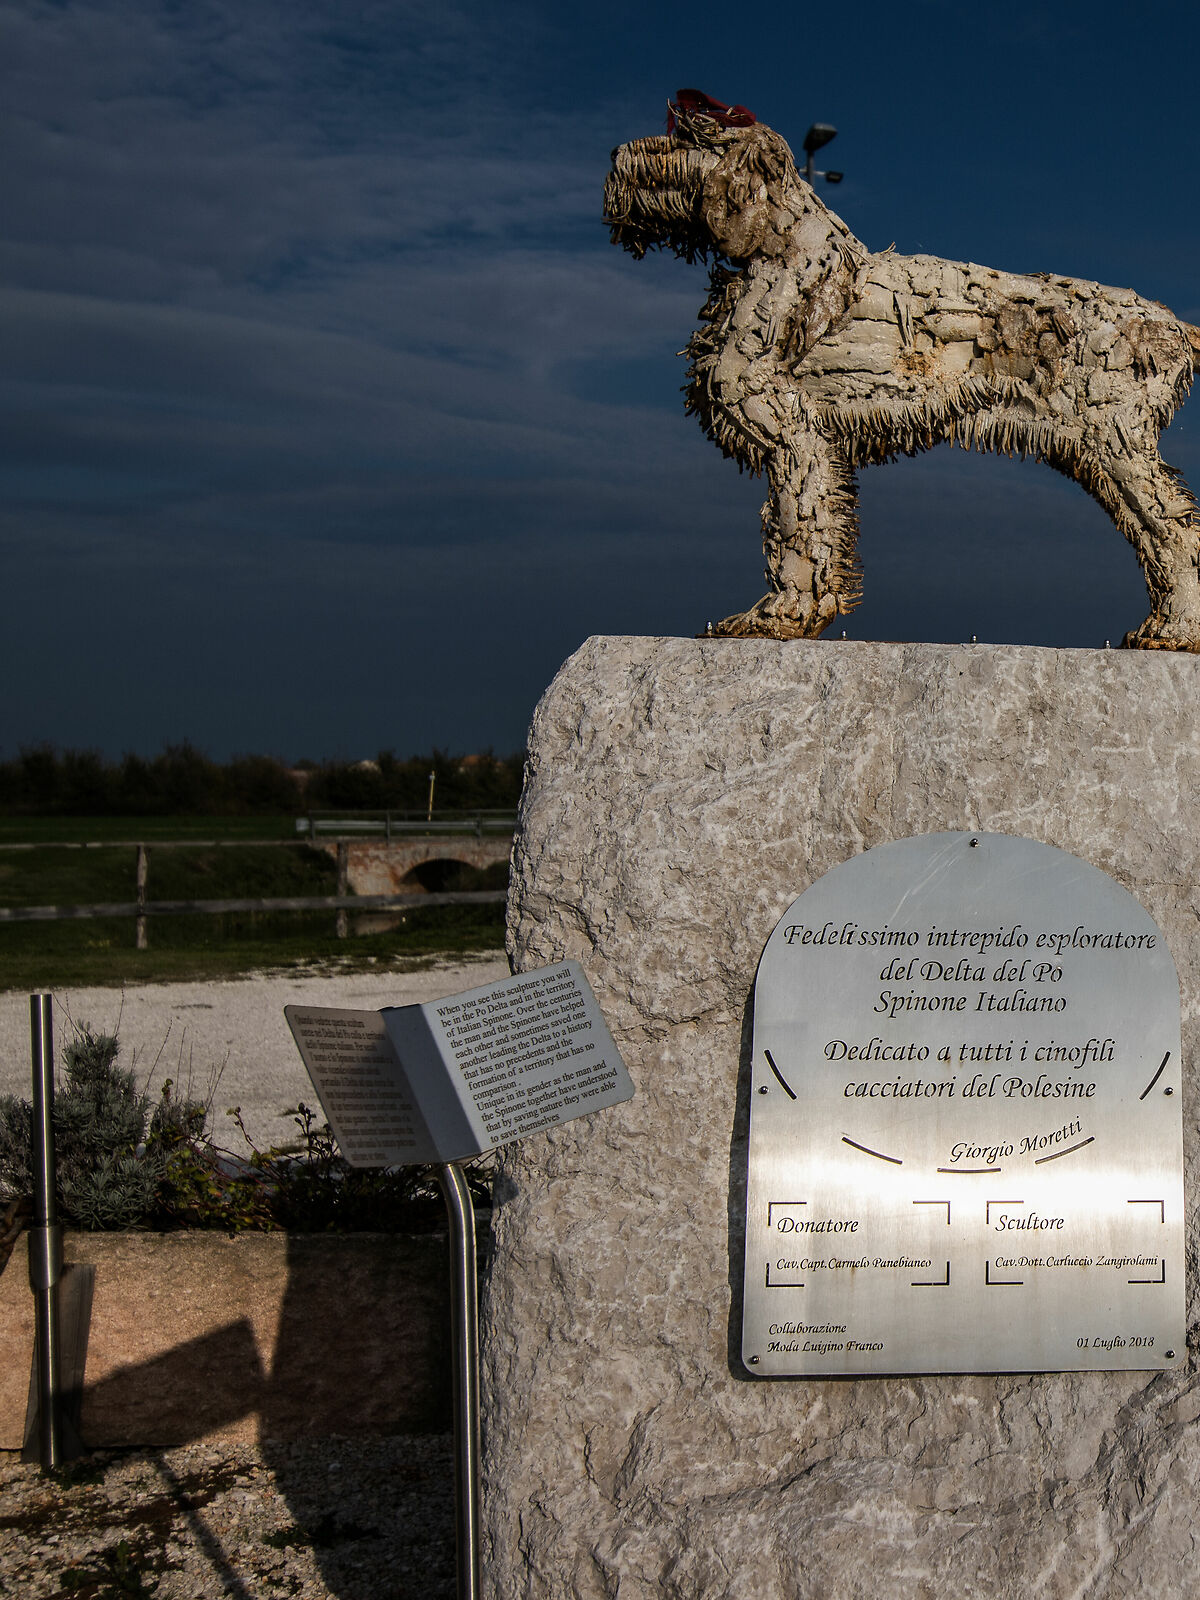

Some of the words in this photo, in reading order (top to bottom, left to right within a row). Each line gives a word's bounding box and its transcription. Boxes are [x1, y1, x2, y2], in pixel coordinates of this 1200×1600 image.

[784, 922, 919, 946] Fedelissimo
[927, 925, 1028, 954] intrepido
[1036, 926, 1156, 955] esploratore
[880, 958, 916, 980] del
[920, 960, 986, 981] Delta
[993, 961, 1027, 982] del
[1033, 963, 1062, 982] Po
[436, 1005, 462, 1017] When
[461, 1000, 477, 1013] you
[477, 995, 491, 1006] see
[490, 989, 506, 1001] this
[505, 980, 541, 996] sculpture
[540, 975, 556, 988] you
[555, 968, 572, 980] will
[461, 1011, 475, 1022] the
[486, 1001, 509, 1014] Delta
[508, 994, 524, 1007] and
[532, 989, 546, 999] the
[545, 979, 576, 995] territory
[874, 990, 967, 1018] Spinone
[976, 989, 1066, 1012] Italiano
[450, 1039, 464, 1049] the
[463, 1033, 482, 1045] man
[481, 1026, 497, 1039] and
[496, 1024, 510, 1034] the
[509, 1014, 542, 1030] Spinone
[540, 1008, 560, 1020] have
[559, 997, 586, 1014] helped
[456, 1021, 483, 1035] Italian
[481, 1011, 516, 1028] Spinone.
[515, 1004, 536, 1016] Over
[535, 999, 549, 1010] the
[549, 989, 583, 1006] centuries
[455, 1046, 474, 1060] each
[473, 1041, 494, 1053] other
[494, 1033, 510, 1047] and
[510, 1022, 550, 1042] sometimes
[550, 1013, 573, 1028] saved
[572, 1011, 587, 1021] one
[459, 1054, 488, 1071] another
[488, 1045, 518, 1060] leading
[517, 1040, 531, 1051] the
[530, 1033, 552, 1046] Delta
[566, 1020, 592, 1034] history
[463, 1069, 480, 1081] that
[478, 1065, 494, 1076] has
[505, 1047, 546, 1069] precedents
[545, 1040, 561, 1053] and
[560, 1037, 574, 1048] the
[468, 1072, 508, 1091] formation
[523, 1056, 555, 1072] territory
[555, 1049, 572, 1061] that
[569, 1046, 585, 1056] has
[824, 1037, 929, 1060] Dedicato
[937, 1046, 951, 1063] a
[960, 1040, 1013, 1063] tutti
[1020, 1040, 1028, 1061] i
[1035, 1039, 1115, 1069] cinofili
[472, 1081, 518, 1101] comparison
[476, 1096, 506, 1112] Unique
[514, 1089, 526, 1099] its
[526, 1080, 552, 1097] gender
[562, 1072, 575, 1082] the
[575, 1066, 593, 1078] man
[592, 1059, 608, 1072] and
[480, 1112, 495, 1122] the
[494, 1101, 527, 1119] Spinone
[526, 1090, 558, 1107] together
[557, 1083, 577, 1096] have
[577, 1067, 618, 1089] understood
[844, 1076, 956, 1097] cacciatori
[962, 1075, 998, 1097] del
[1003, 1076, 1096, 1097] Polesine
[485, 1121, 502, 1133] that
[513, 1109, 540, 1124] saving
[538, 1100, 564, 1115] nature
[563, 1094, 580, 1106] they
[580, 1087, 600, 1099] were
[600, 1080, 617, 1093] able
[499, 1128, 518, 1141] save
[517, 1113, 561, 1134] themselves
[950, 1141, 1013, 1164] Giorgio
[1020, 1116, 1083, 1153] Moretti
[777, 1216, 858, 1233] Donatore
[995, 1213, 1064, 1231] Scultore
[872, 1256, 932, 1268] Panebianco
[1096, 1255, 1158, 1269] Zangirolami
[769, 1322, 847, 1335] Collaborazione
[1077, 1337, 1090, 1348] 01
[1093, 1336, 1126, 1351] Luglio
[1129, 1336, 1154, 1348] 2018
[767, 1340, 799, 1353] Moda
[802, 1341, 844, 1355] Luigino
[846, 1340, 884, 1352] Franco
